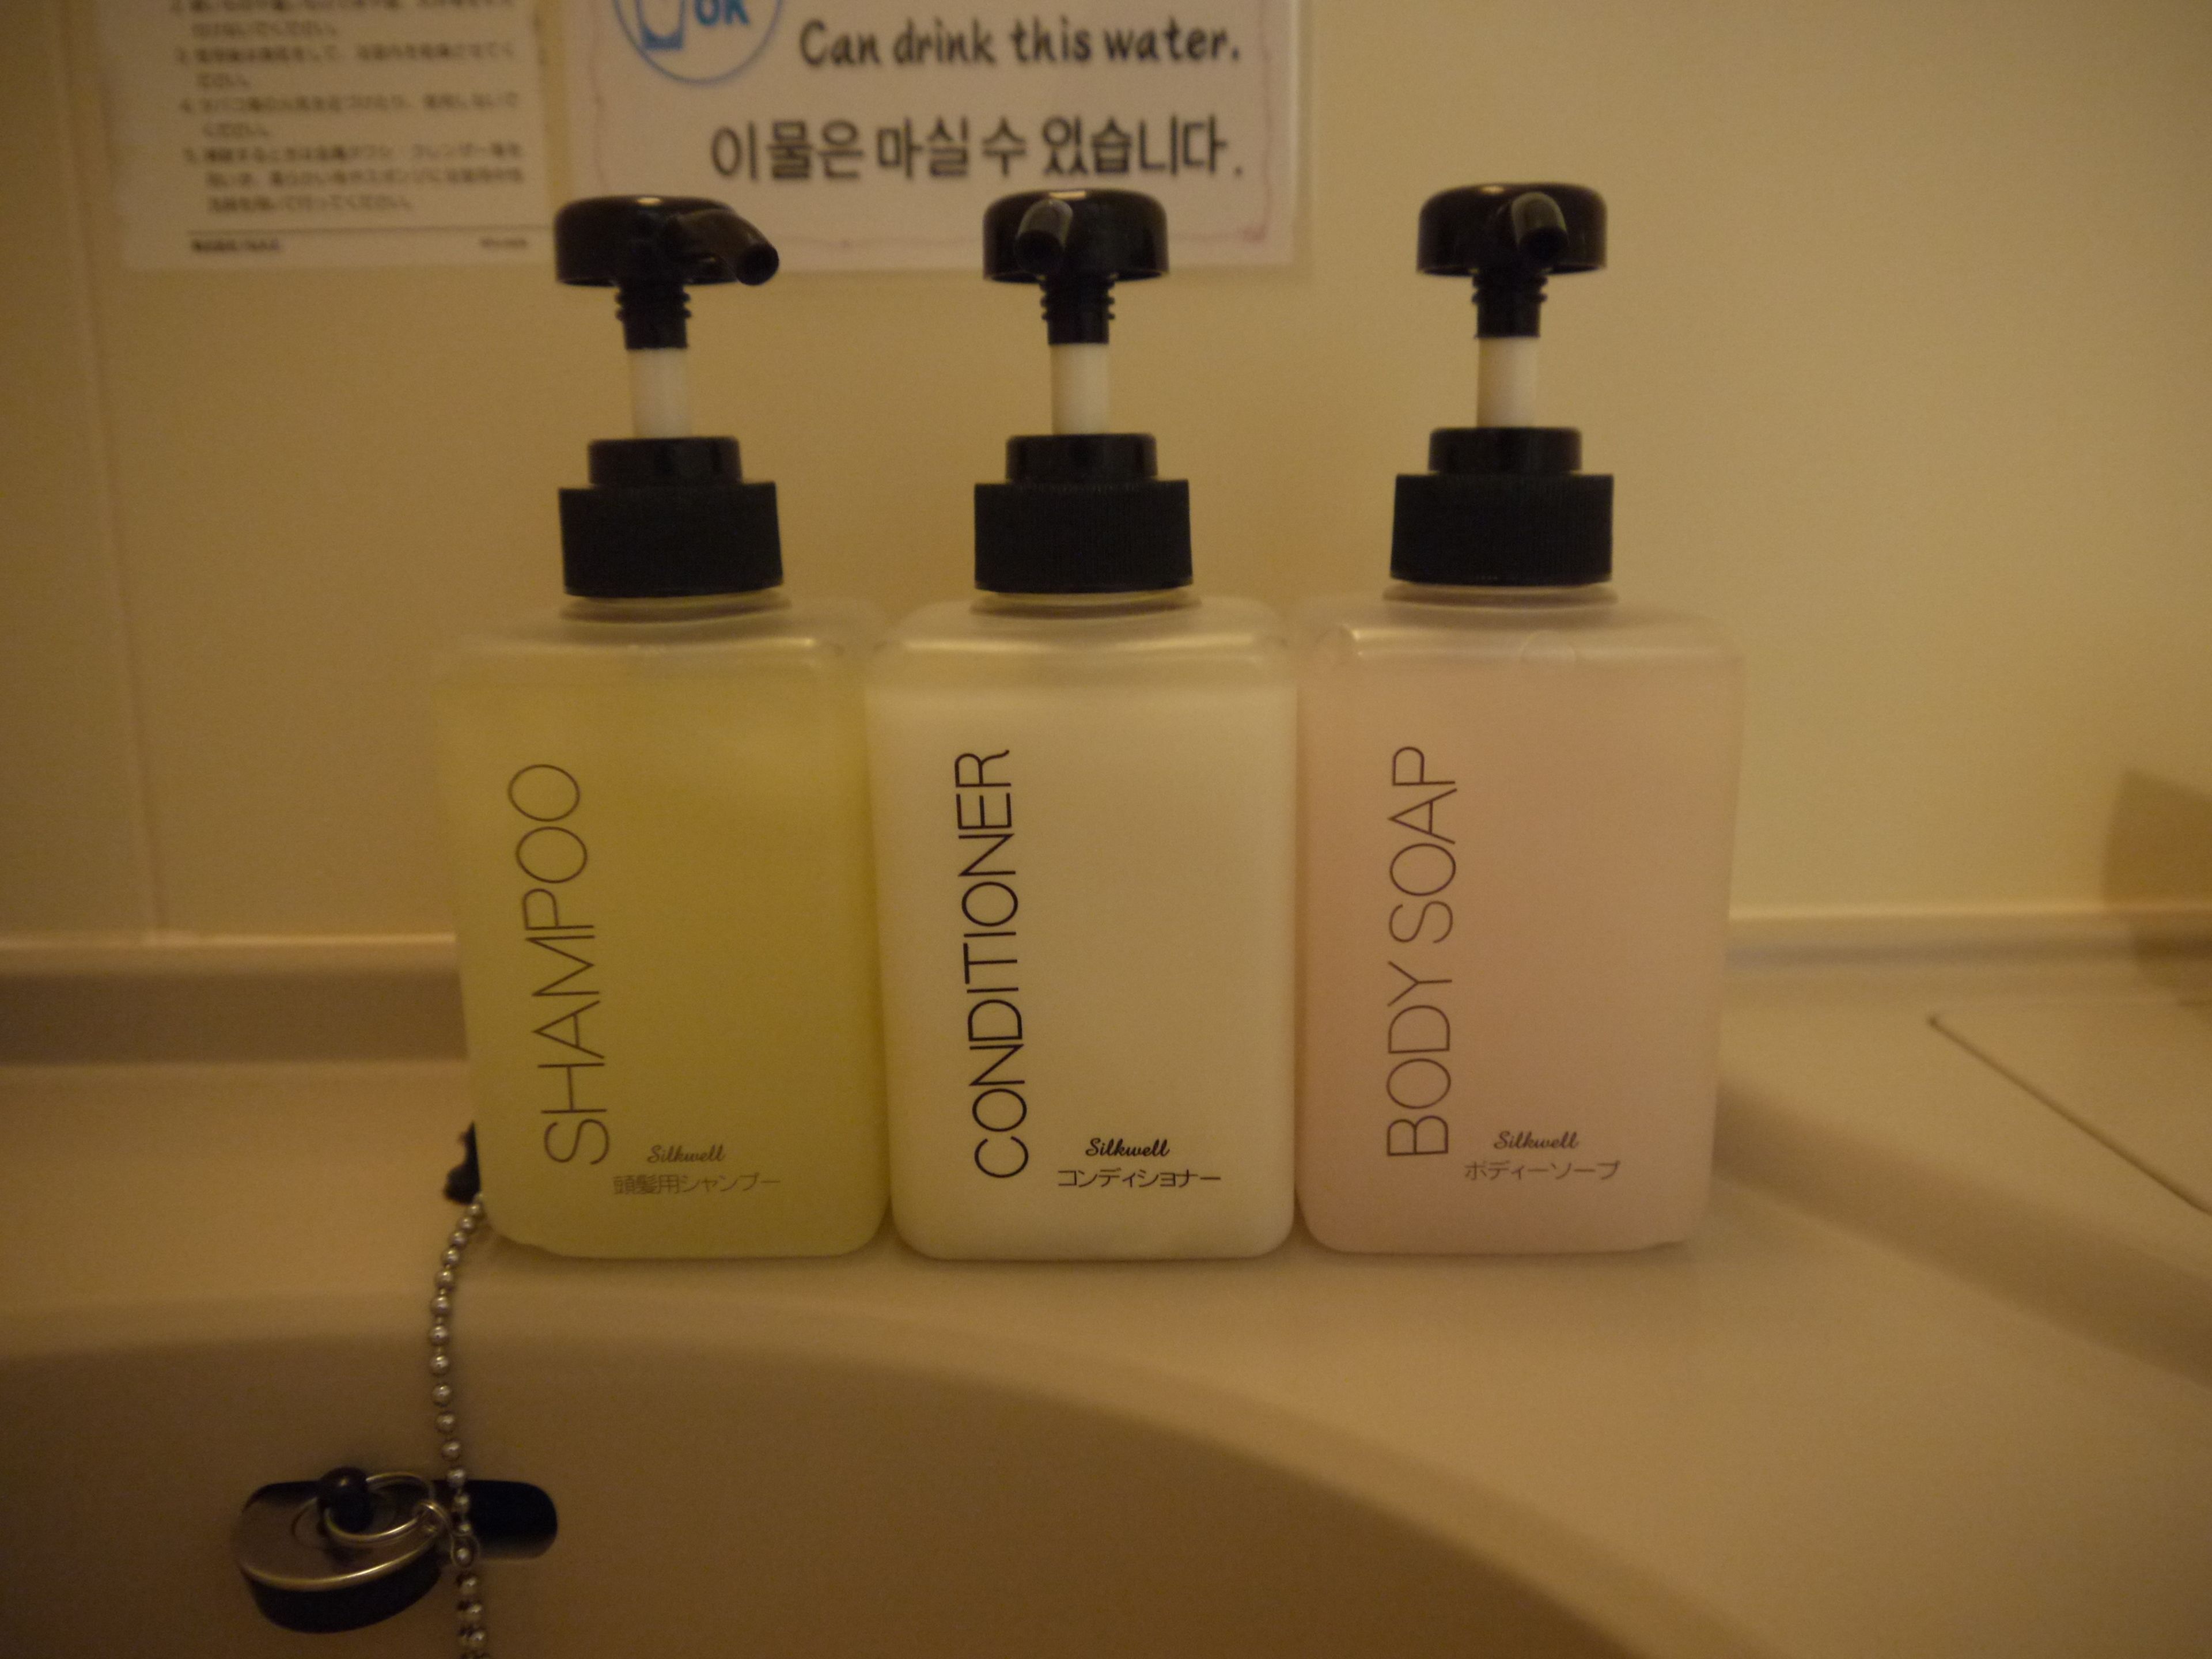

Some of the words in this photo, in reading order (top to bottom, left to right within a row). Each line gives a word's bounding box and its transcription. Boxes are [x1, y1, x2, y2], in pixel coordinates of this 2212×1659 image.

[800, 18, 880, 66] Can
[893, 17, 996, 64] drink
[1010, 14, 1092, 63] this
[1103, 15, 1240, 62] water.
[1388, 746, 1457, 944] SOAP
[508, 764, 609, 1165] SHAMPOO
[954, 749, 1029, 1178] CONDITIONER
[1387, 960, 1452, 1157] BODY
[646, 1144, 726, 1163] Silkwell
[1085, 1137, 1171, 1158] Silkwell
[1493, 1130, 1579, 1149] Silkwell
[1058, 1167, 1222, 1188] コンディショナー
[1464, 1160, 1621, 1180] ボディーソープ
